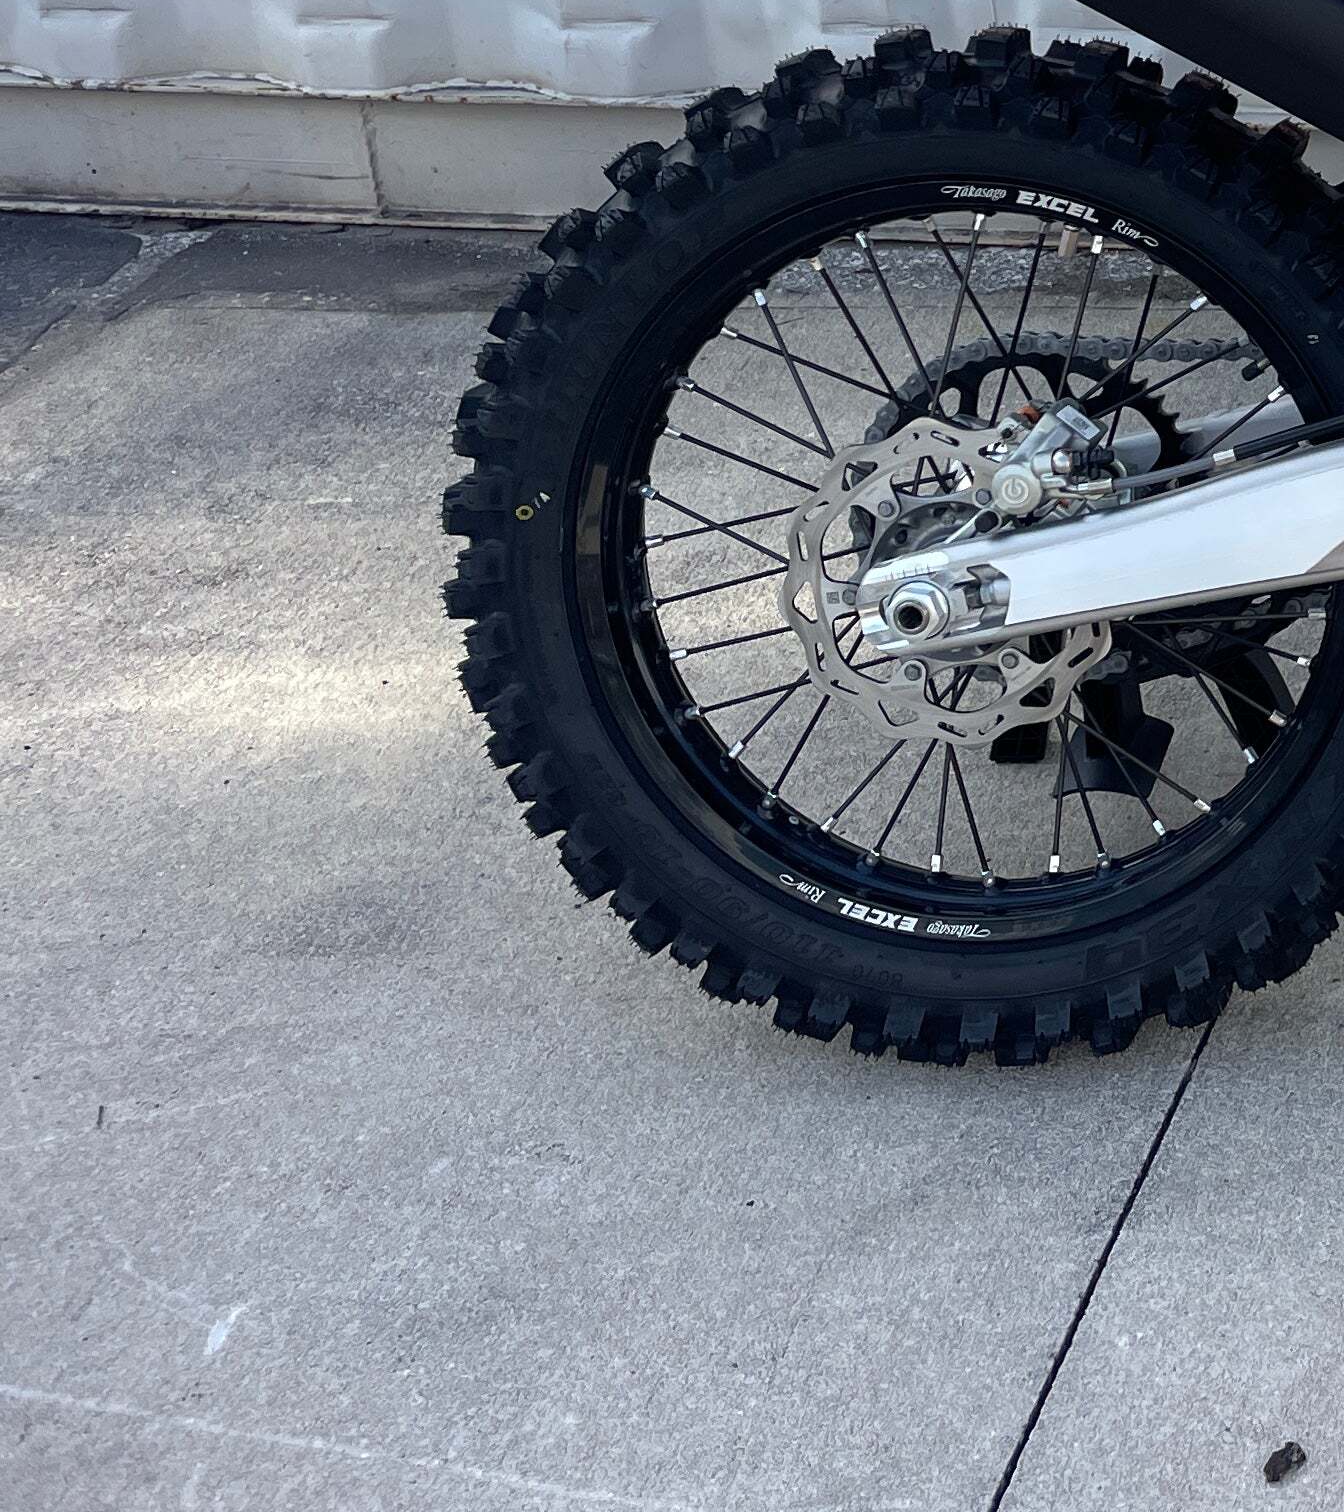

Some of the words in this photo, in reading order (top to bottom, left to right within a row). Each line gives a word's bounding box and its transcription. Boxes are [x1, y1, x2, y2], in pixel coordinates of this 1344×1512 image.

[1015, 190, 1099, 223] EXCEL
[1111, 218, 1159, 247] Rim
[778, 873, 826, 903] Rim
[837, 897, 920, 933] EXCEL
